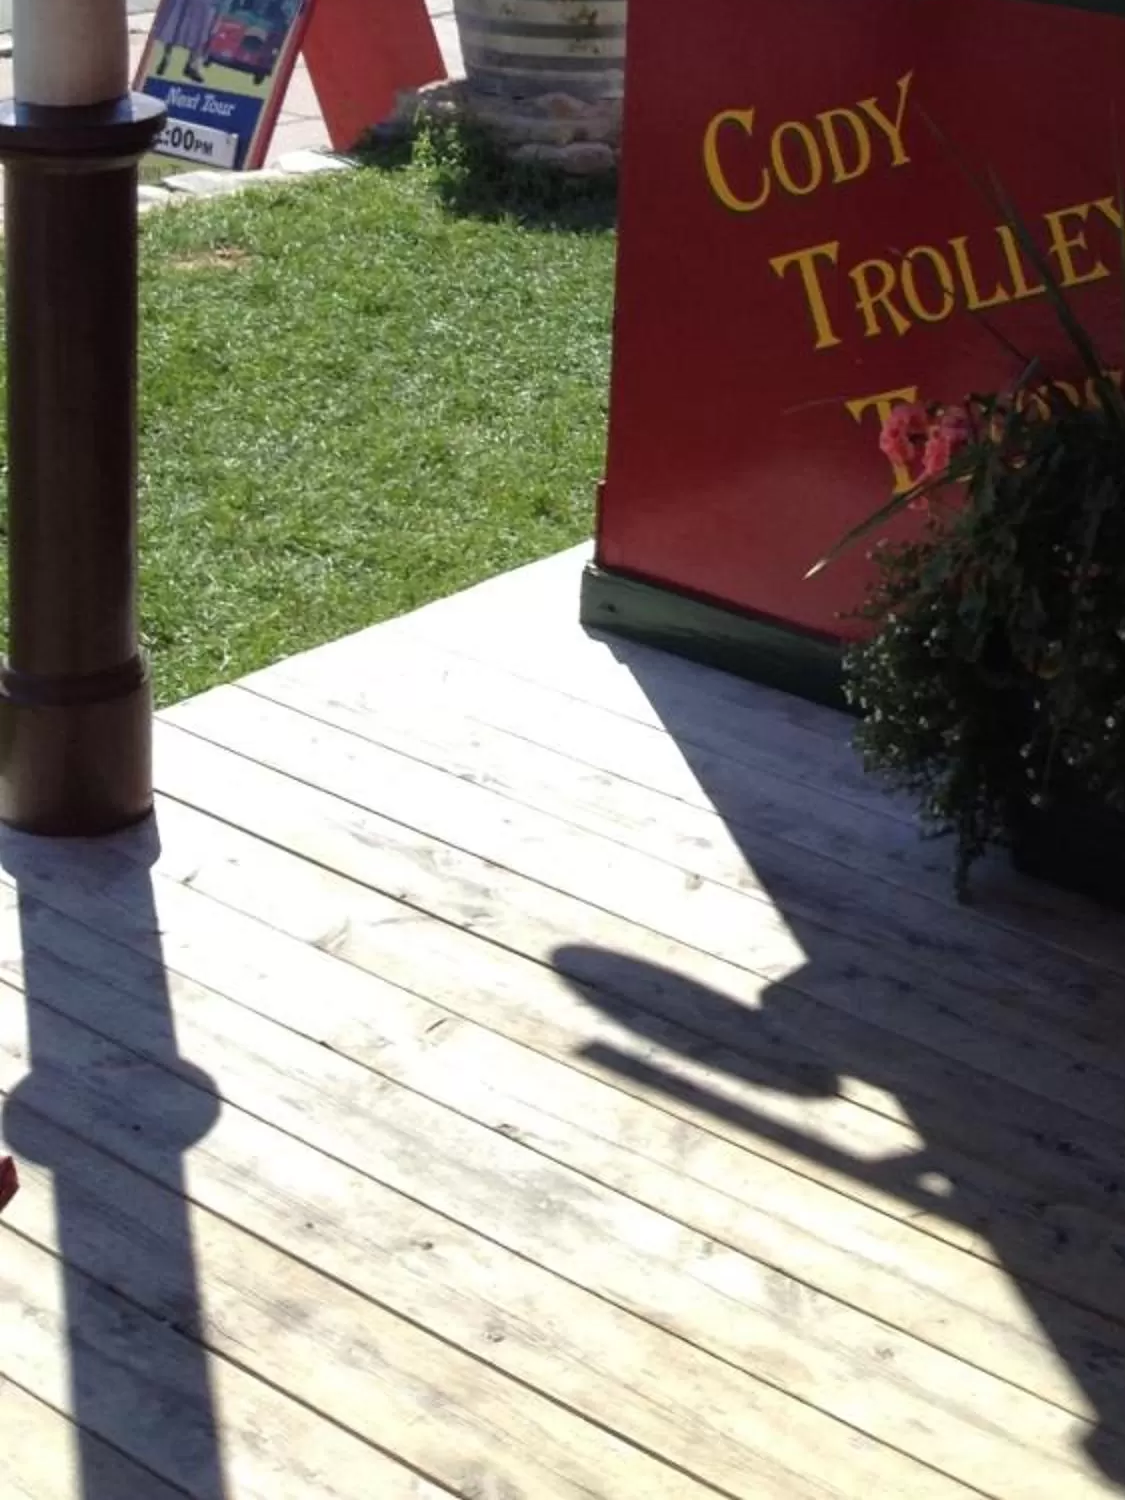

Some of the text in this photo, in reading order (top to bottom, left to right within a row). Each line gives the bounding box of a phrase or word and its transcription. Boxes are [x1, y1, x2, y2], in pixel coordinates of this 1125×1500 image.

[165, 86, 237, 117] Next Tour
[703, 69, 913, 212] CODY
